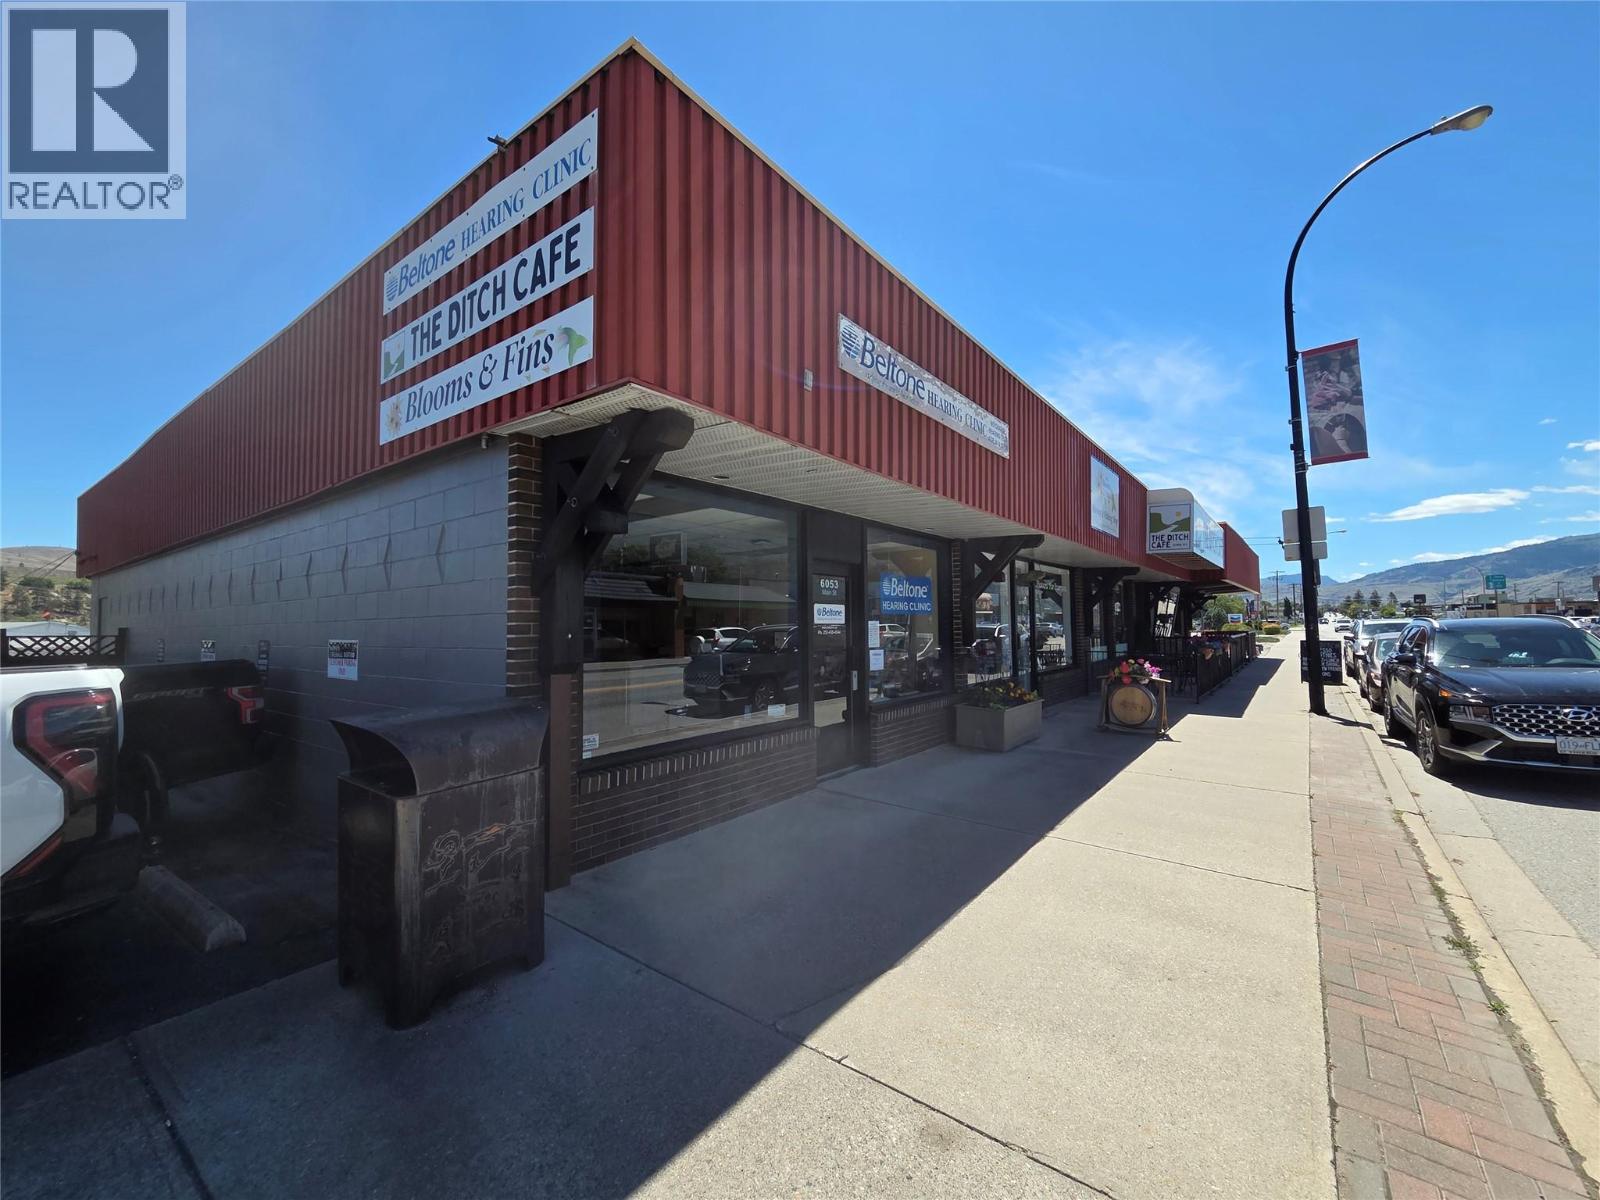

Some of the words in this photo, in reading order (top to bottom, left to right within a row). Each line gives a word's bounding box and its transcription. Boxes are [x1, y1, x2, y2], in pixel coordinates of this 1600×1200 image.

[398, 238, 456, 297] Beltone
[461, 187, 524, 252] HEARING
[532, 138, 592, 199] CLINIC
[411, 310, 442, 361] THE
[448, 269, 506, 341] DITCH
[513, 222, 581, 301] CAFE
[405, 371, 473, 424] Blooms
[479, 353, 498, 391] &
[502, 333, 555, 382] Fins
[860, 331, 926, 400] Beltone
[927, 389, 963, 424] HEARING
[965, 411, 987, 437] CLINIC
[1151, 534, 1166, 542] THE
[1168, 533, 1189, 541] DITCH
[1151, 541, 1171, 549] CAFE
[820, 578, 839, 589] 6053
[891, 577, 928, 598] Beltone
[822, 607, 843, 617] Beltone
[882, 600, 909, 611] HEARING
[909, 602, 932, 612] CLINIC
